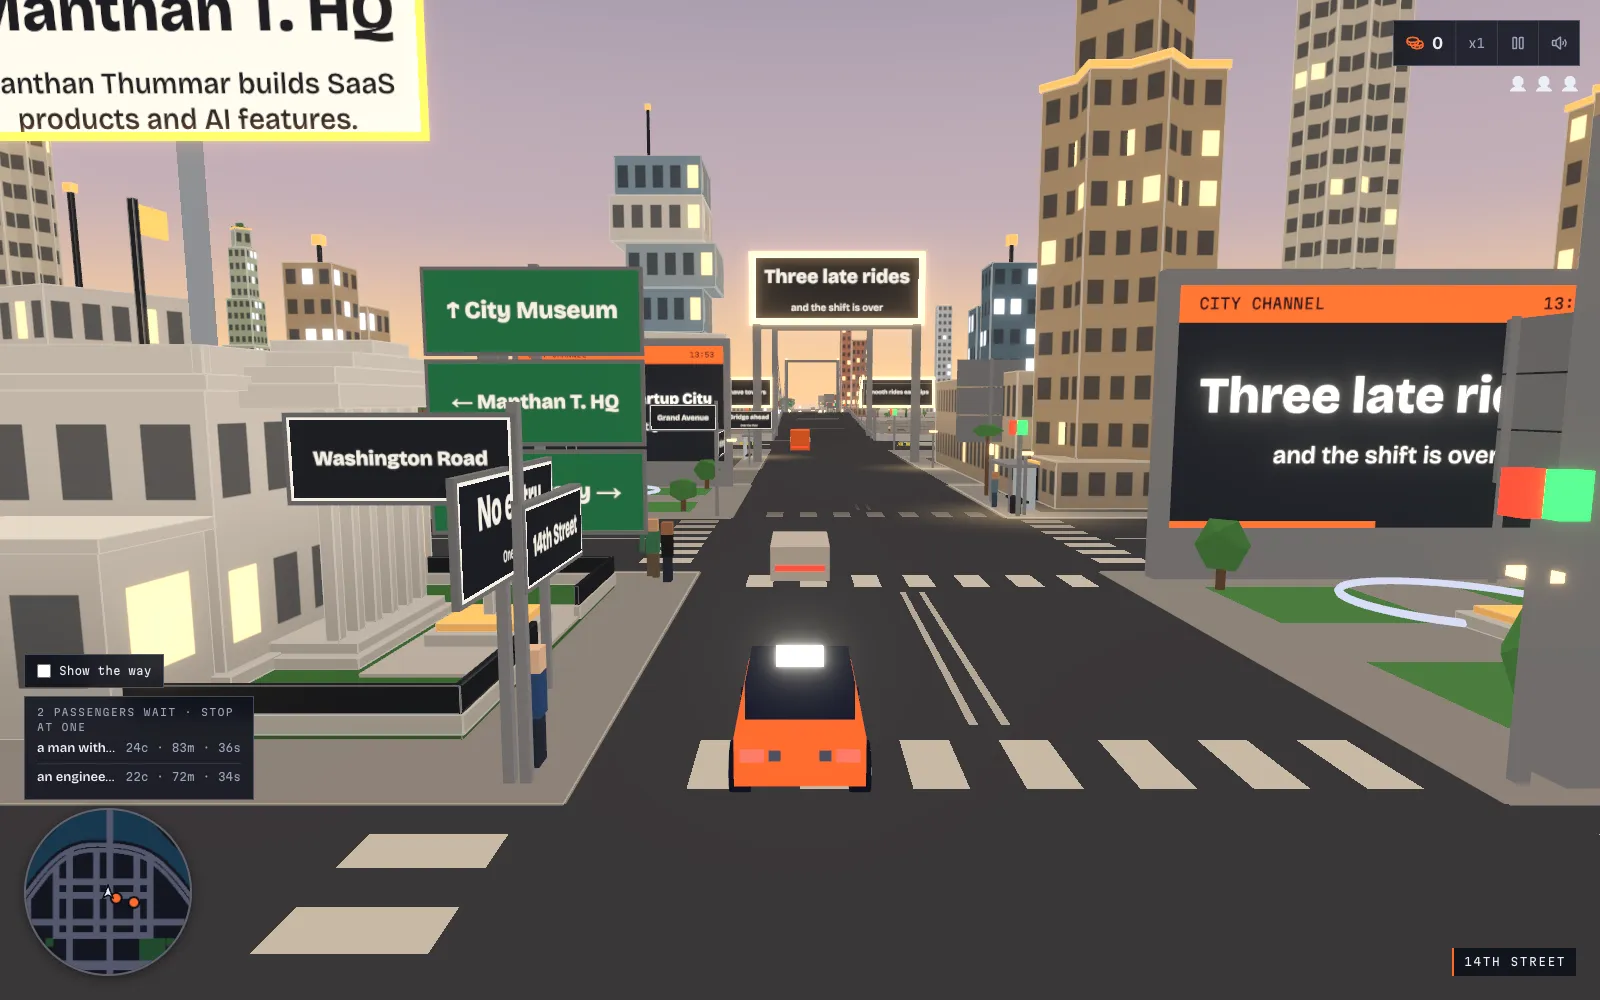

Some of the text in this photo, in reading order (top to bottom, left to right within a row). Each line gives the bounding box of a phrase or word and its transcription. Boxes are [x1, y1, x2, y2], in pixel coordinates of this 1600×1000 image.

[310, 0, 394, 42] HQ
[101, 71, 231, 95] Thummar
[239, 71, 320, 95] builds
[328, 72, 395, 95] SaaS
[18, 107, 358, 132] products and AI features.
[764, 268, 911, 285] Three late rides
[465, 299, 618, 323] City Museum
[790, 303, 809, 312] and
[811, 303, 826, 312] the
[828, 303, 850, 312] shift
[852, 303, 860, 312] is
[1199, 296, 1325, 311] CITY CHANNEL
[690, 350, 715, 359] 13:53
[569, 394, 587, 410] T.
[590, 394, 620, 413] HQ
[645, 394, 680, 405] rtup
[1200, 375, 1340, 414] Three
[1353, 375, 1444, 414] late
[656, 413, 710, 422] Grand Avenue
[750, 413, 769, 421] ahead
[312, 450, 488, 470] Washington Road
[1272, 445, 1496, 465] and the shift is over
[477, 494, 502, 532] No
[533, 514, 578, 557] 14th Street
